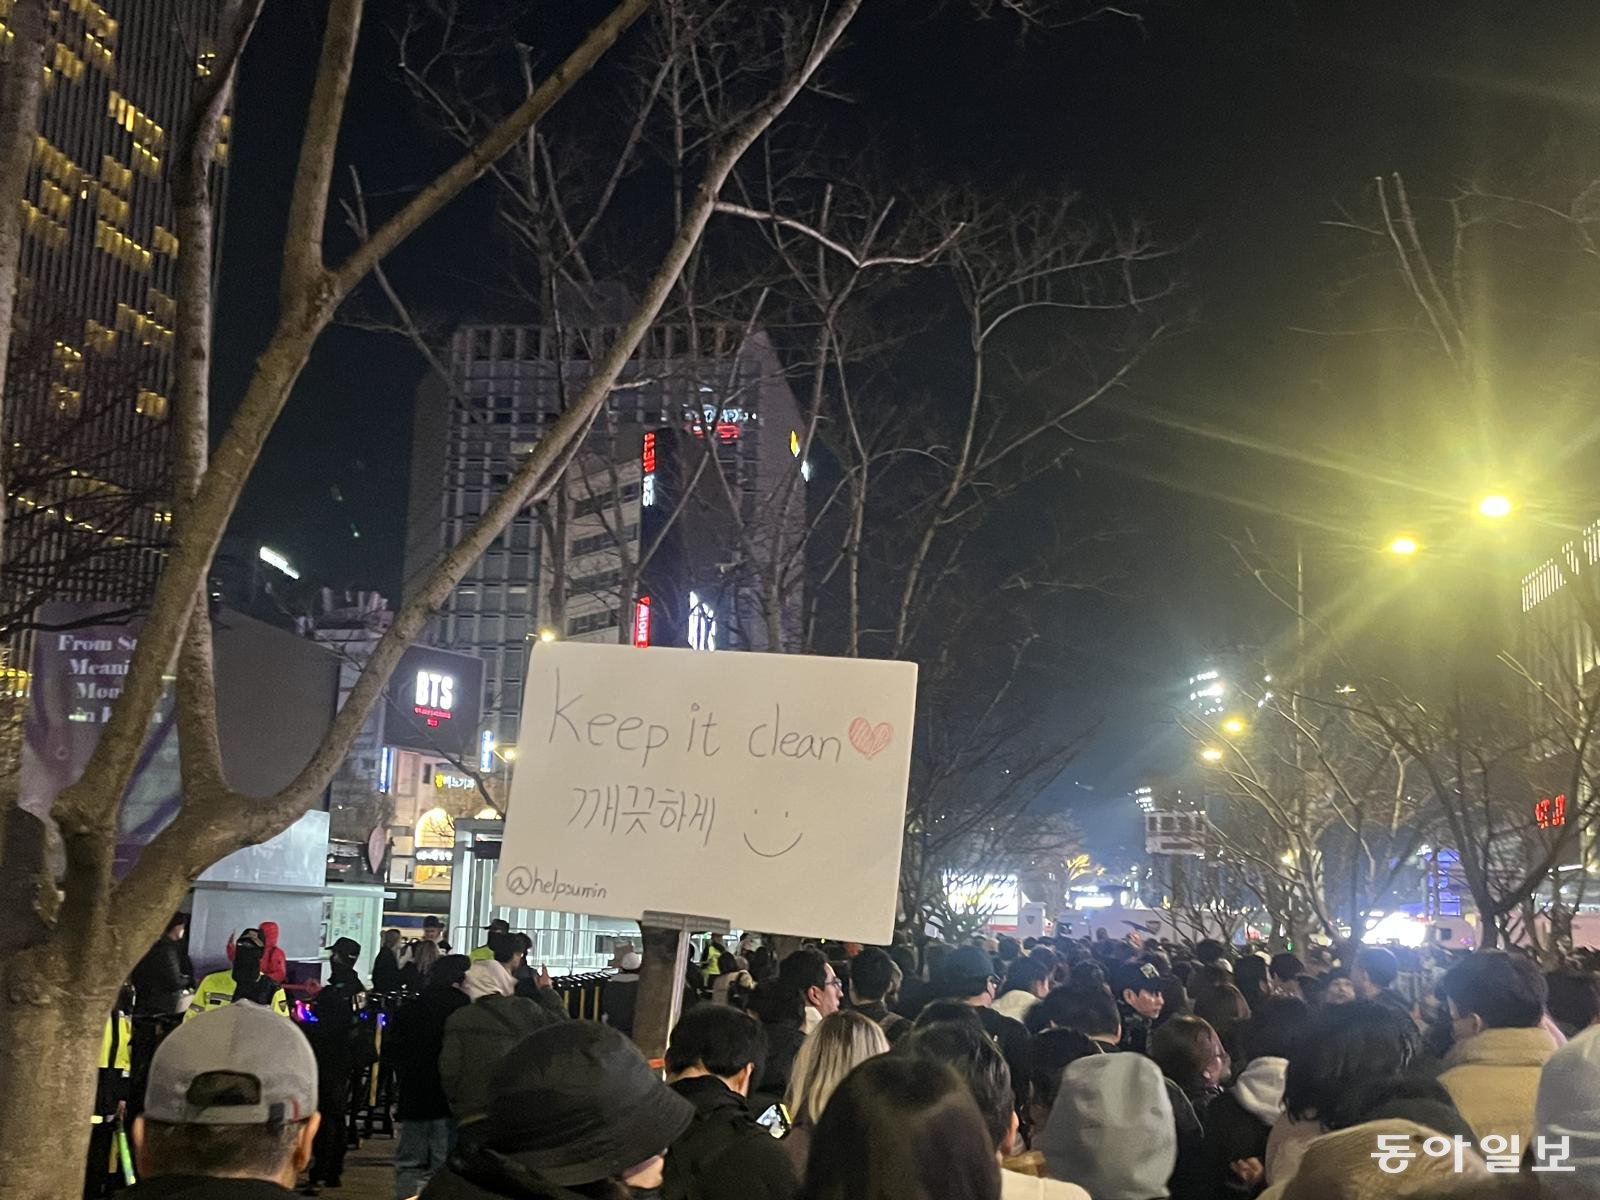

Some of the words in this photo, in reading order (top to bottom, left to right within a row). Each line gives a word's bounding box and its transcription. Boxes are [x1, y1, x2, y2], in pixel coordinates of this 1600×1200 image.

[58, 635, 112, 651] From
[69, 659, 130, 675] Meani
[416, 671, 453, 710] BTS
[549, 667, 669, 768] Keep
[687, 702, 720, 757] it
[748, 703, 842, 763] clean
[568, 785, 717, 847] 깨끗하게
[506, 866, 607, 902] @helpsumin
